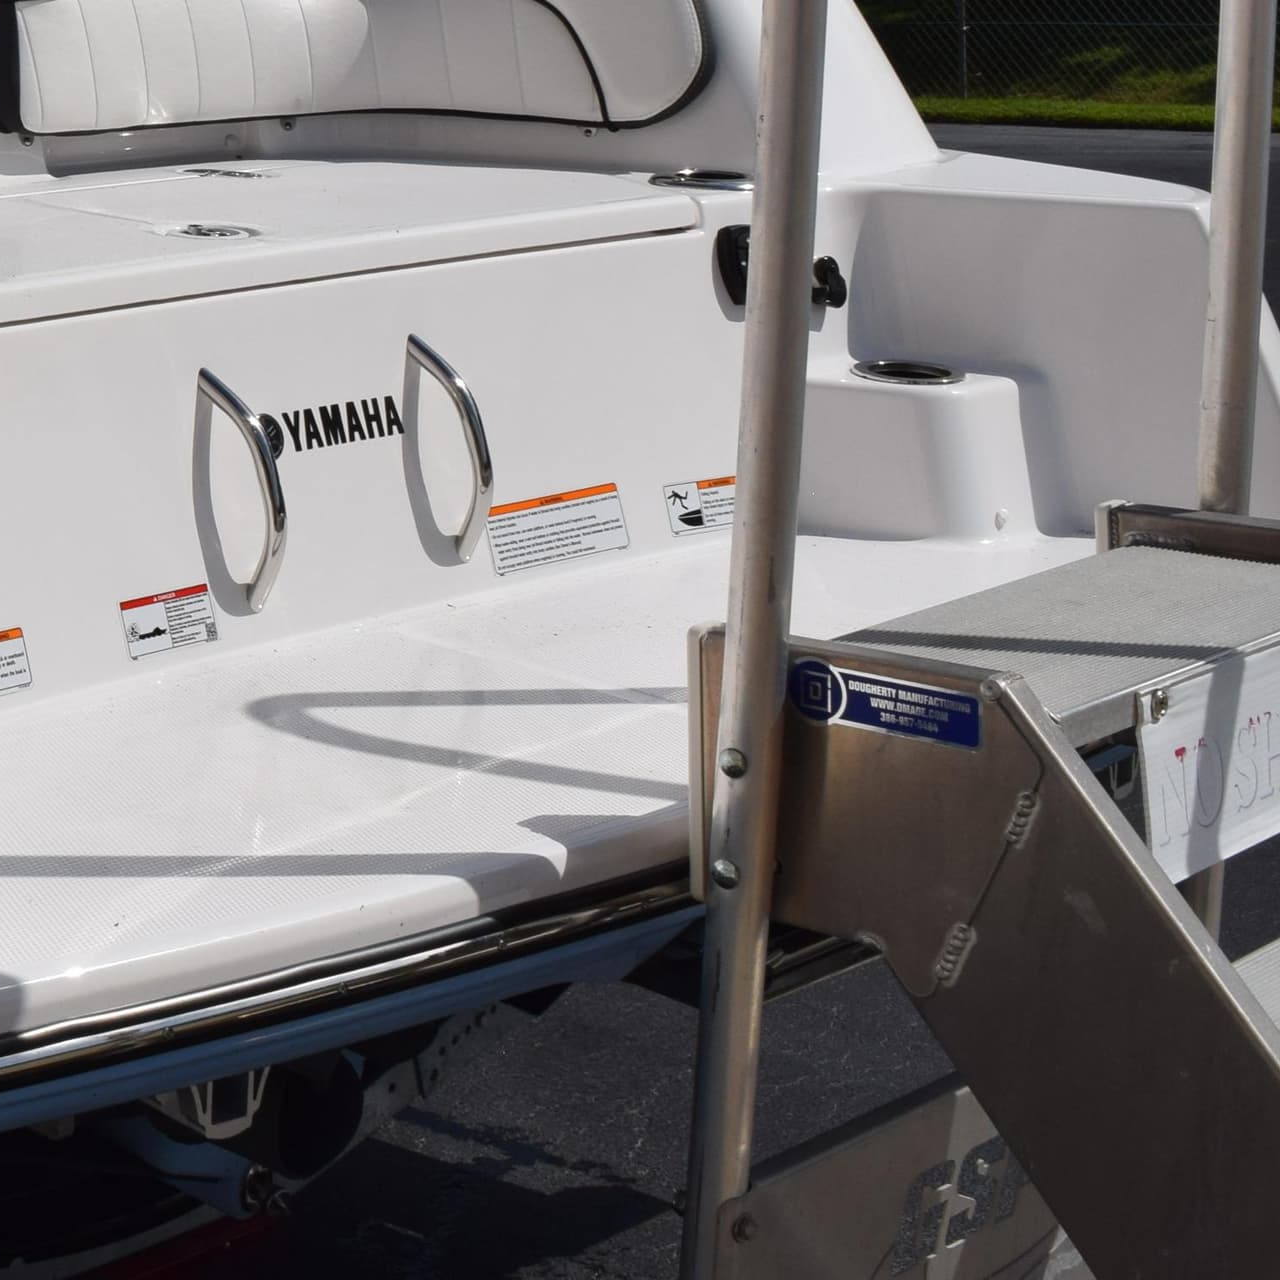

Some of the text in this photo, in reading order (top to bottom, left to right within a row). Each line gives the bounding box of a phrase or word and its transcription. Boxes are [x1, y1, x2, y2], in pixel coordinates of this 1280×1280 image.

[281, 395, 406, 453] YAMAHA
[848, 679, 971, 715] DOUGHERTY MANUFACTURING
